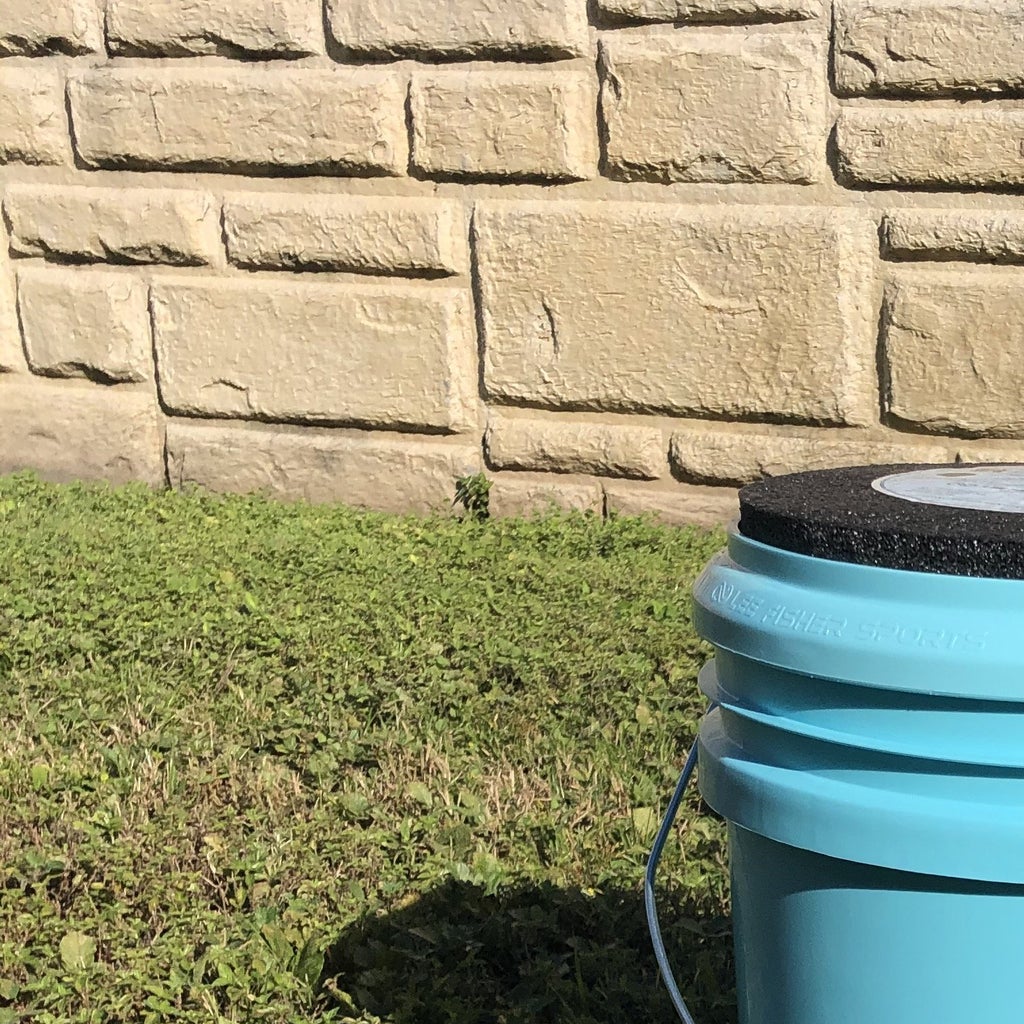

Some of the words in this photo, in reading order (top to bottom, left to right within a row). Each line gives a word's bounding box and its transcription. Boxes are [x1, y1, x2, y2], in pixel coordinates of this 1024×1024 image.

[729, 590, 764, 618] LEE
[761, 604, 848, 638] FISHER
[854, 620, 990, 650] SPORTS
